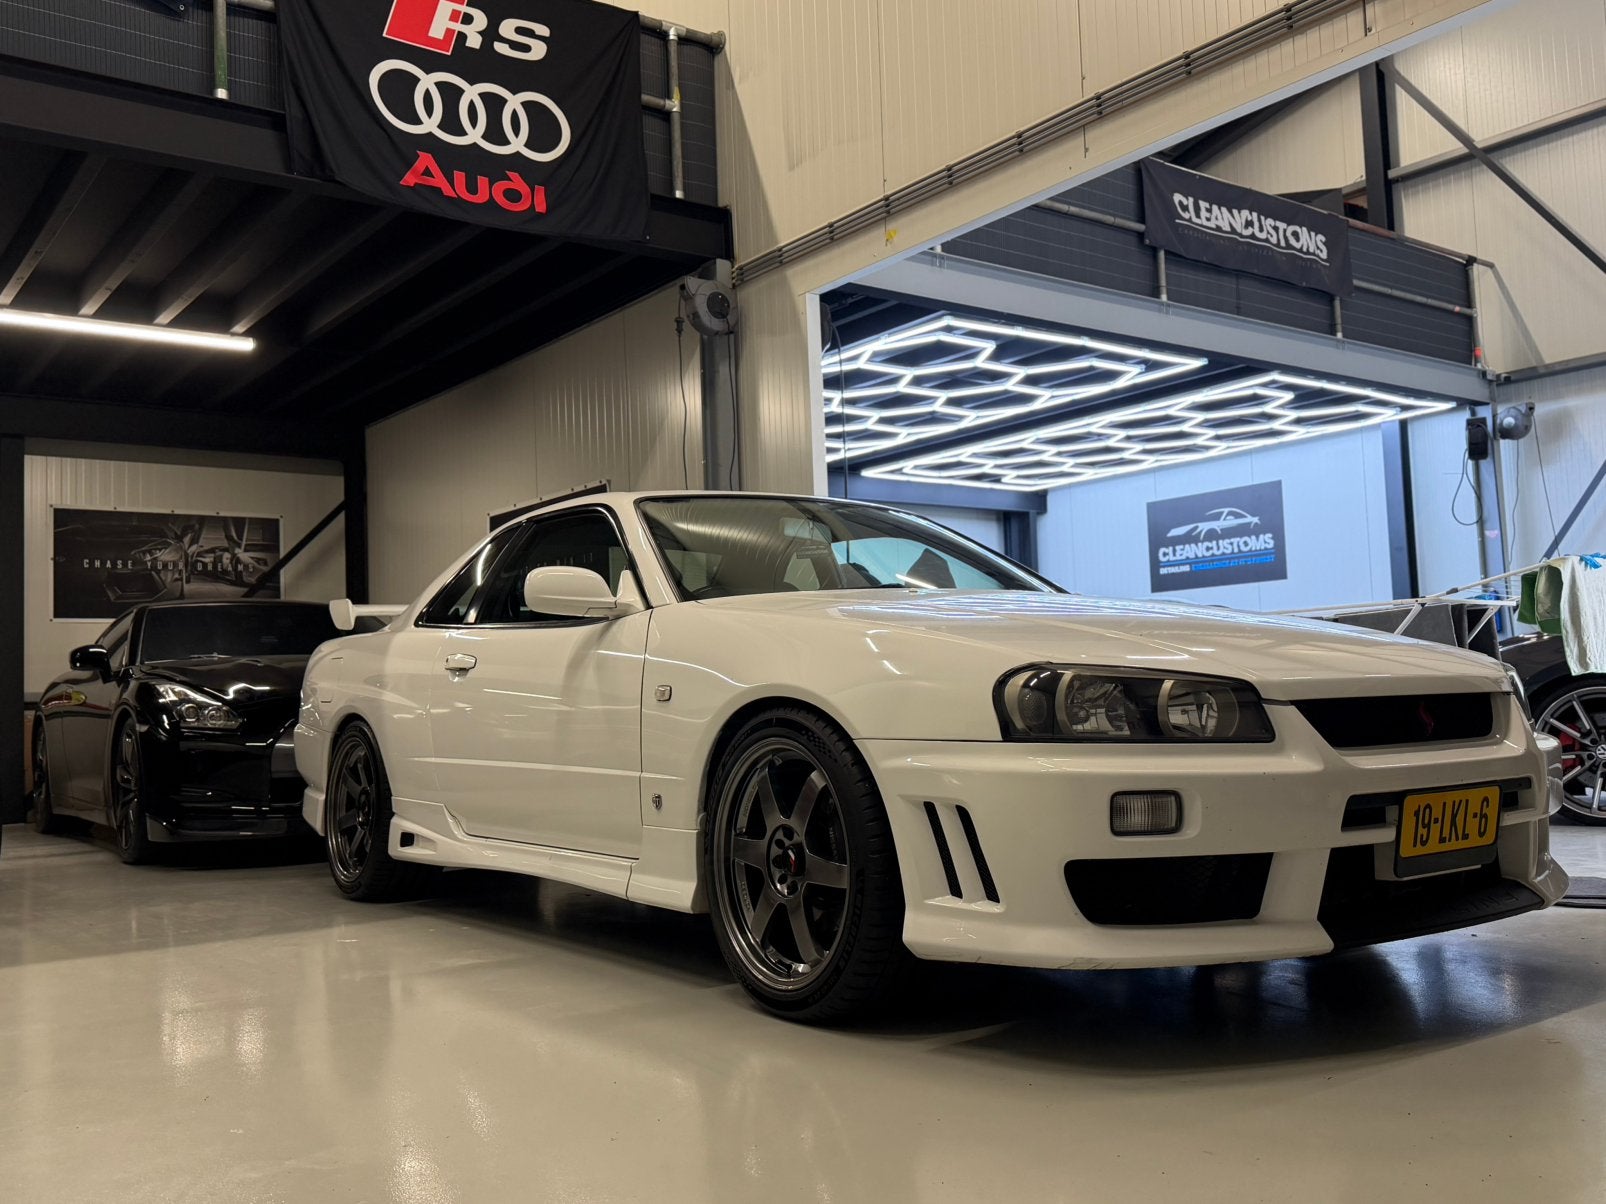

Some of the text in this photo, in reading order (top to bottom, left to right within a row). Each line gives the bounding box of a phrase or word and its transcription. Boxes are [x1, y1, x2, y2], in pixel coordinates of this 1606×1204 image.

[428, 0, 550, 61] RS
[400, 150, 547, 214] Audi
[1173, 192, 1328, 260] CLEANCUSTOMS
[83, 558, 255, 573] CHASE YOUR DREAMS
[1158, 533, 1275, 562] CLEANCUSTOMS
[1412, 795, 1490, 848] 19-LKL-6
